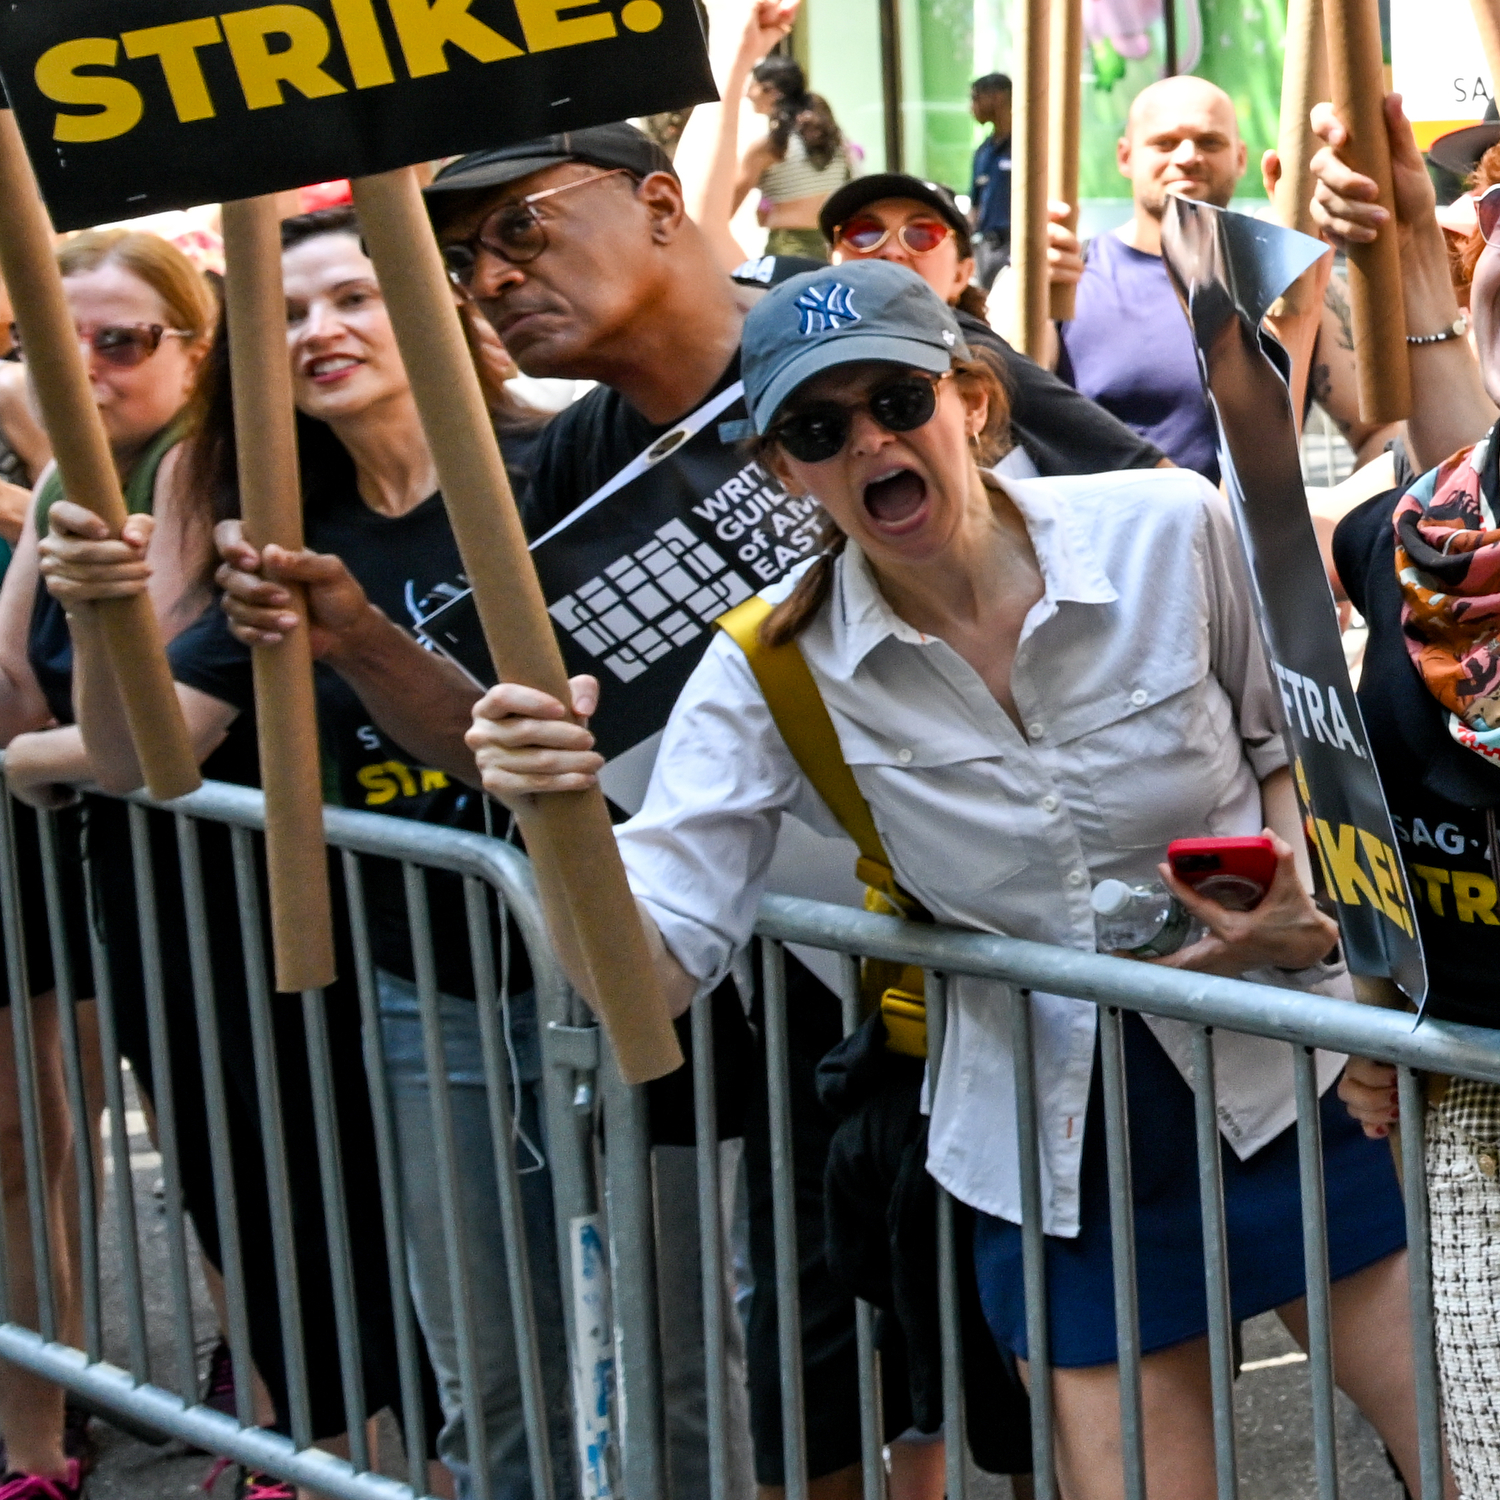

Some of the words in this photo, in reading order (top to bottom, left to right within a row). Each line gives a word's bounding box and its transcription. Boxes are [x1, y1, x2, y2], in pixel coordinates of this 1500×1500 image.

[715, 480, 789, 542] GUIL
[738, 528, 769, 562] of
[751, 515, 823, 582] EAST
